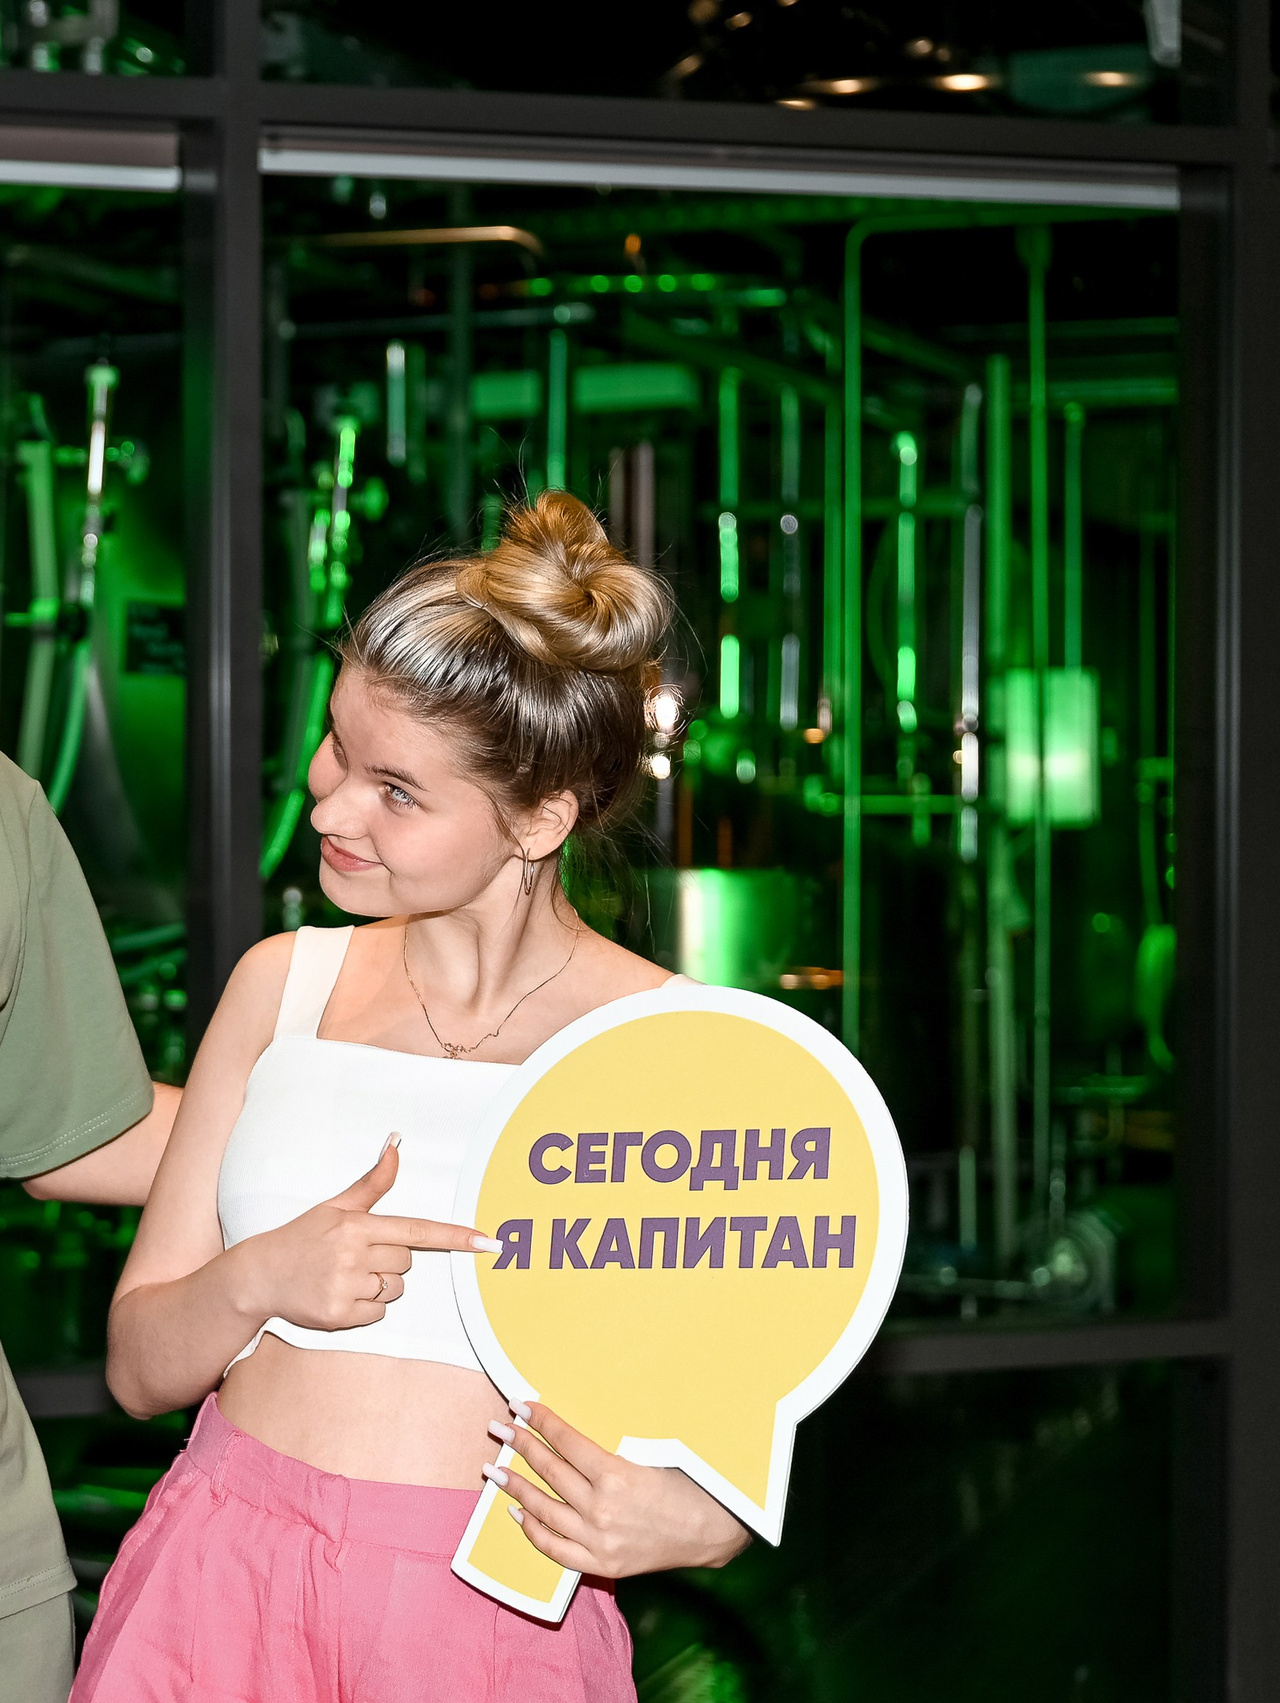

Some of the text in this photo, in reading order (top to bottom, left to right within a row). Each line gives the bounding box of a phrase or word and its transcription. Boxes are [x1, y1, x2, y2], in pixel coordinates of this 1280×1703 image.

[528, 1127, 831, 1191] СЕГОДНЯ
[492, 1215, 857, 1270] Я КАПИТАН
